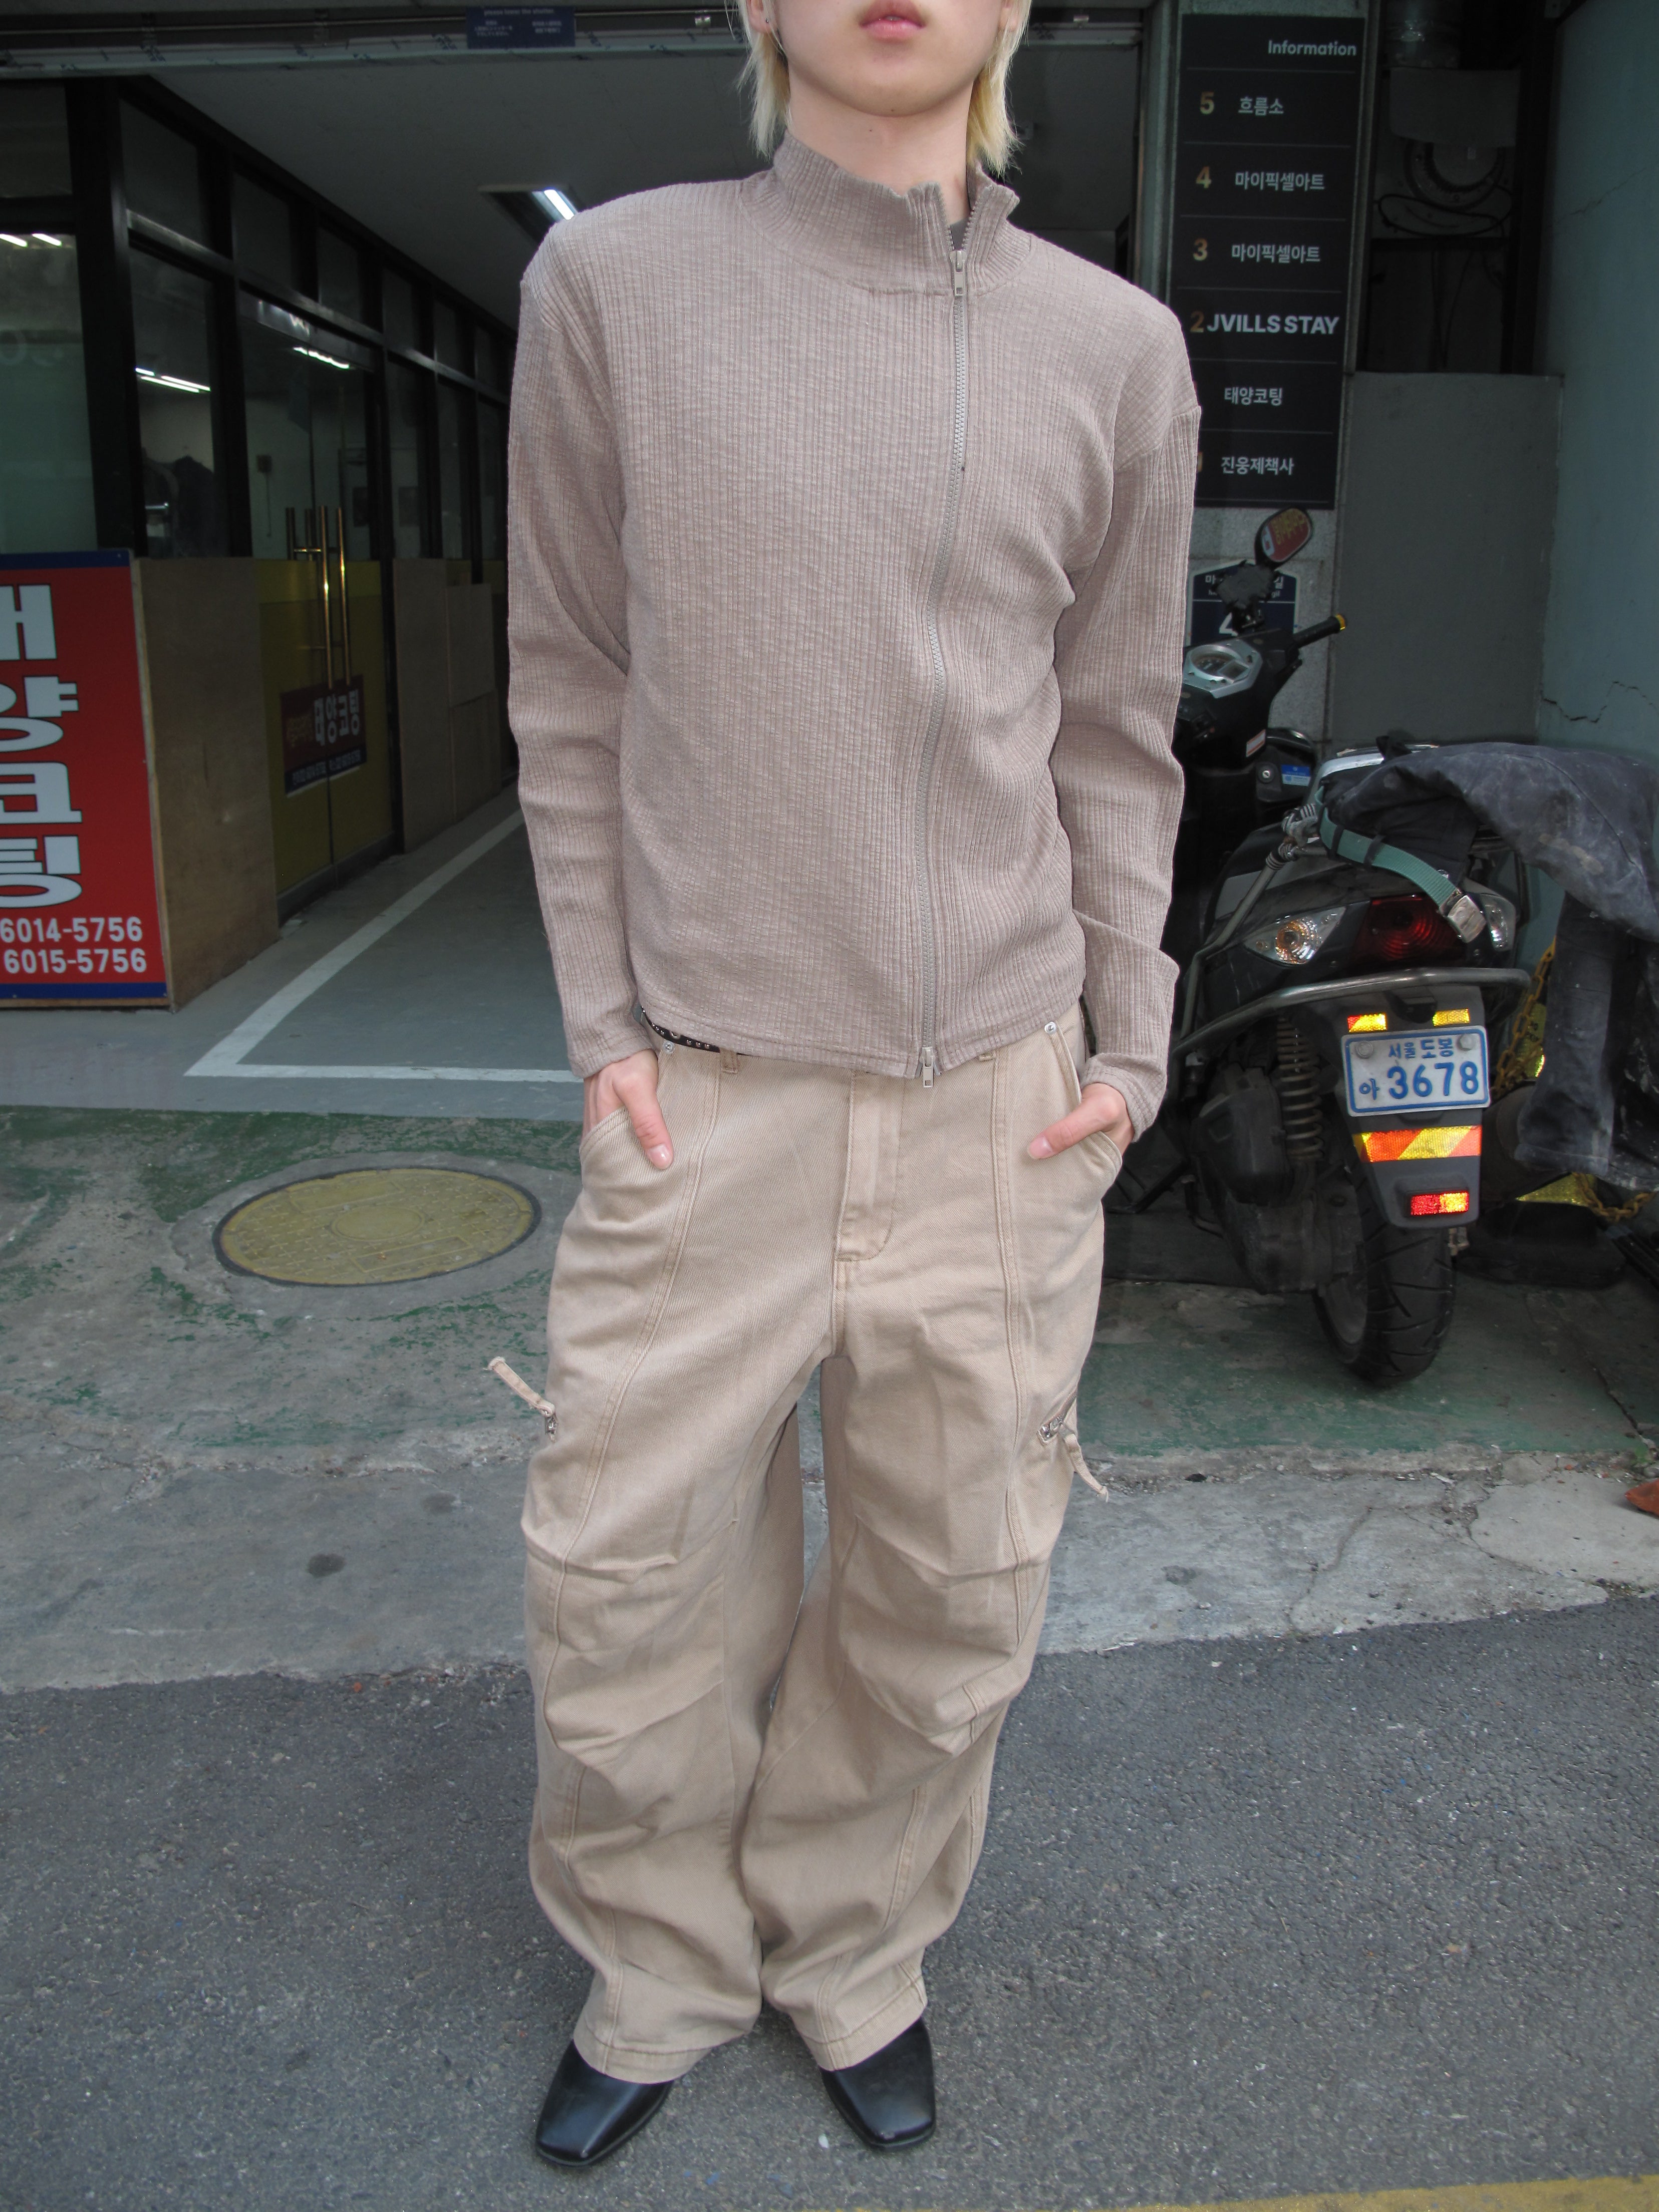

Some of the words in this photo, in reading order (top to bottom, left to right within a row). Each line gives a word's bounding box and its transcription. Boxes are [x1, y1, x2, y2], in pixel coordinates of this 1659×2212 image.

[1268, 40, 1357, 56] Information
[1200, 91, 1215, 115] 5
[1238, 96, 1284, 116] 흐름소
[1196, 166, 1212, 188] 4
[1235, 171, 1325, 191] 마이픽셀아트
[1193, 238, 1208, 261] 3
[1231, 243, 1321, 263] 마이픽셀아트
[1190, 311, 1204, 333] 2
[1207, 314, 1281, 334] JVILLS
[1283, 316, 1340, 335] STAY
[1224, 387, 1283, 407] 태양코팅
[1221, 456, 1295, 475] 진웅제책사
[0, 916, 143, 943] 6014-5756
[4, 948, 147, 974] 6015-5756
[1388, 1041, 1416, 1059] 서울
[1421, 1038, 1454, 1059] 도봉
[1358, 1078, 1379, 1100] 아
[1387, 1061, 1479, 1099] 3678
